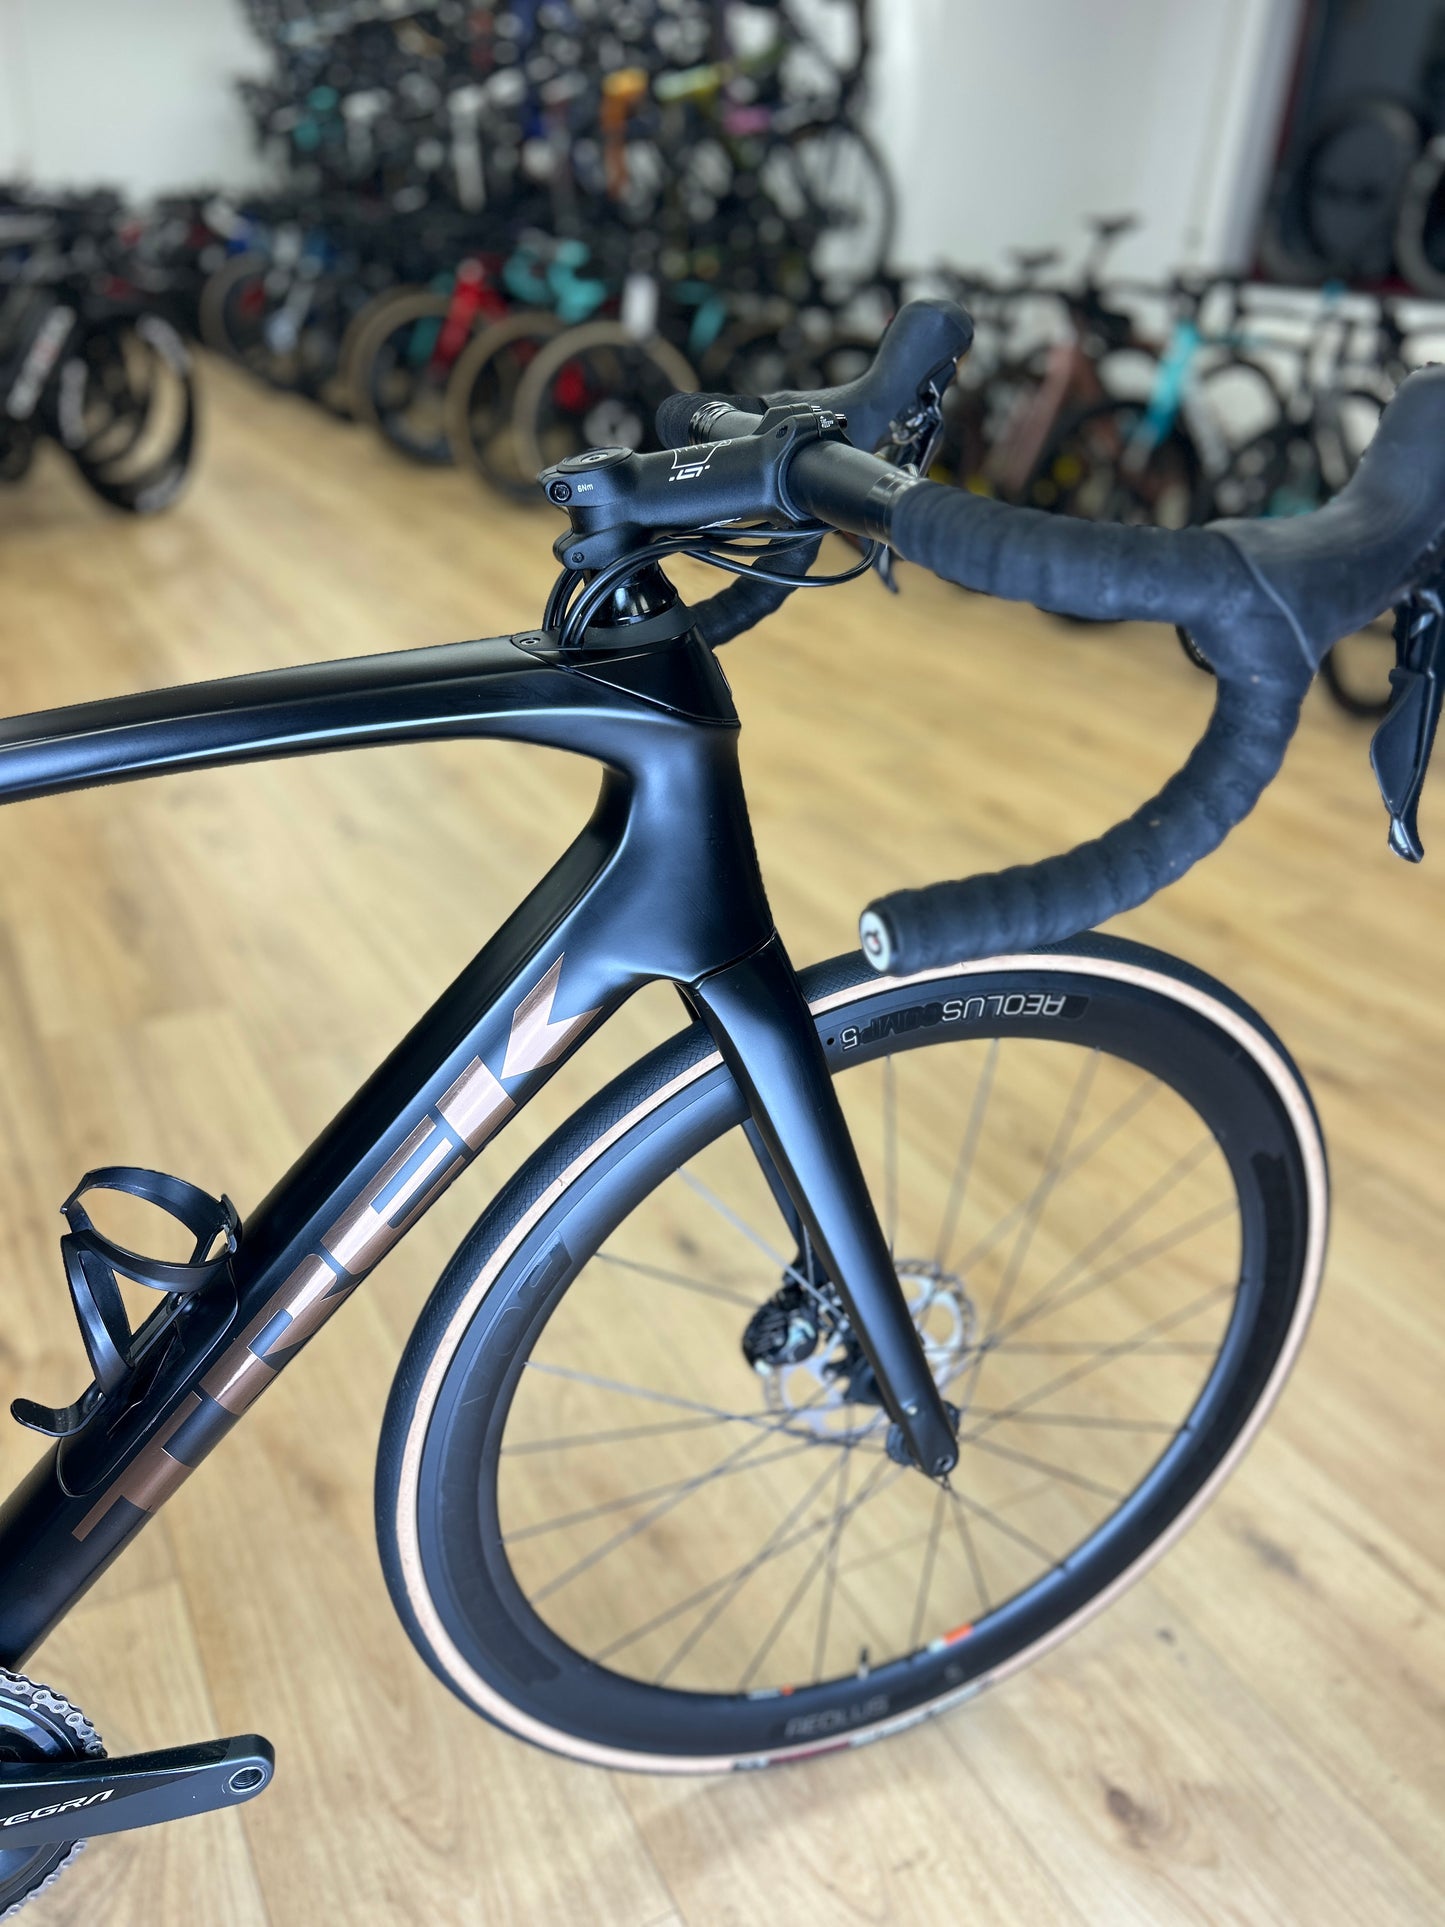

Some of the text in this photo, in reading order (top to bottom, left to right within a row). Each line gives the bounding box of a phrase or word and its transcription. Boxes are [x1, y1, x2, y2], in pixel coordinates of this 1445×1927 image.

[941, 994, 1067, 1022] AEOLUS
[841, 1028, 859, 1050] 5
[72, 952, 604, 1542] TREK
